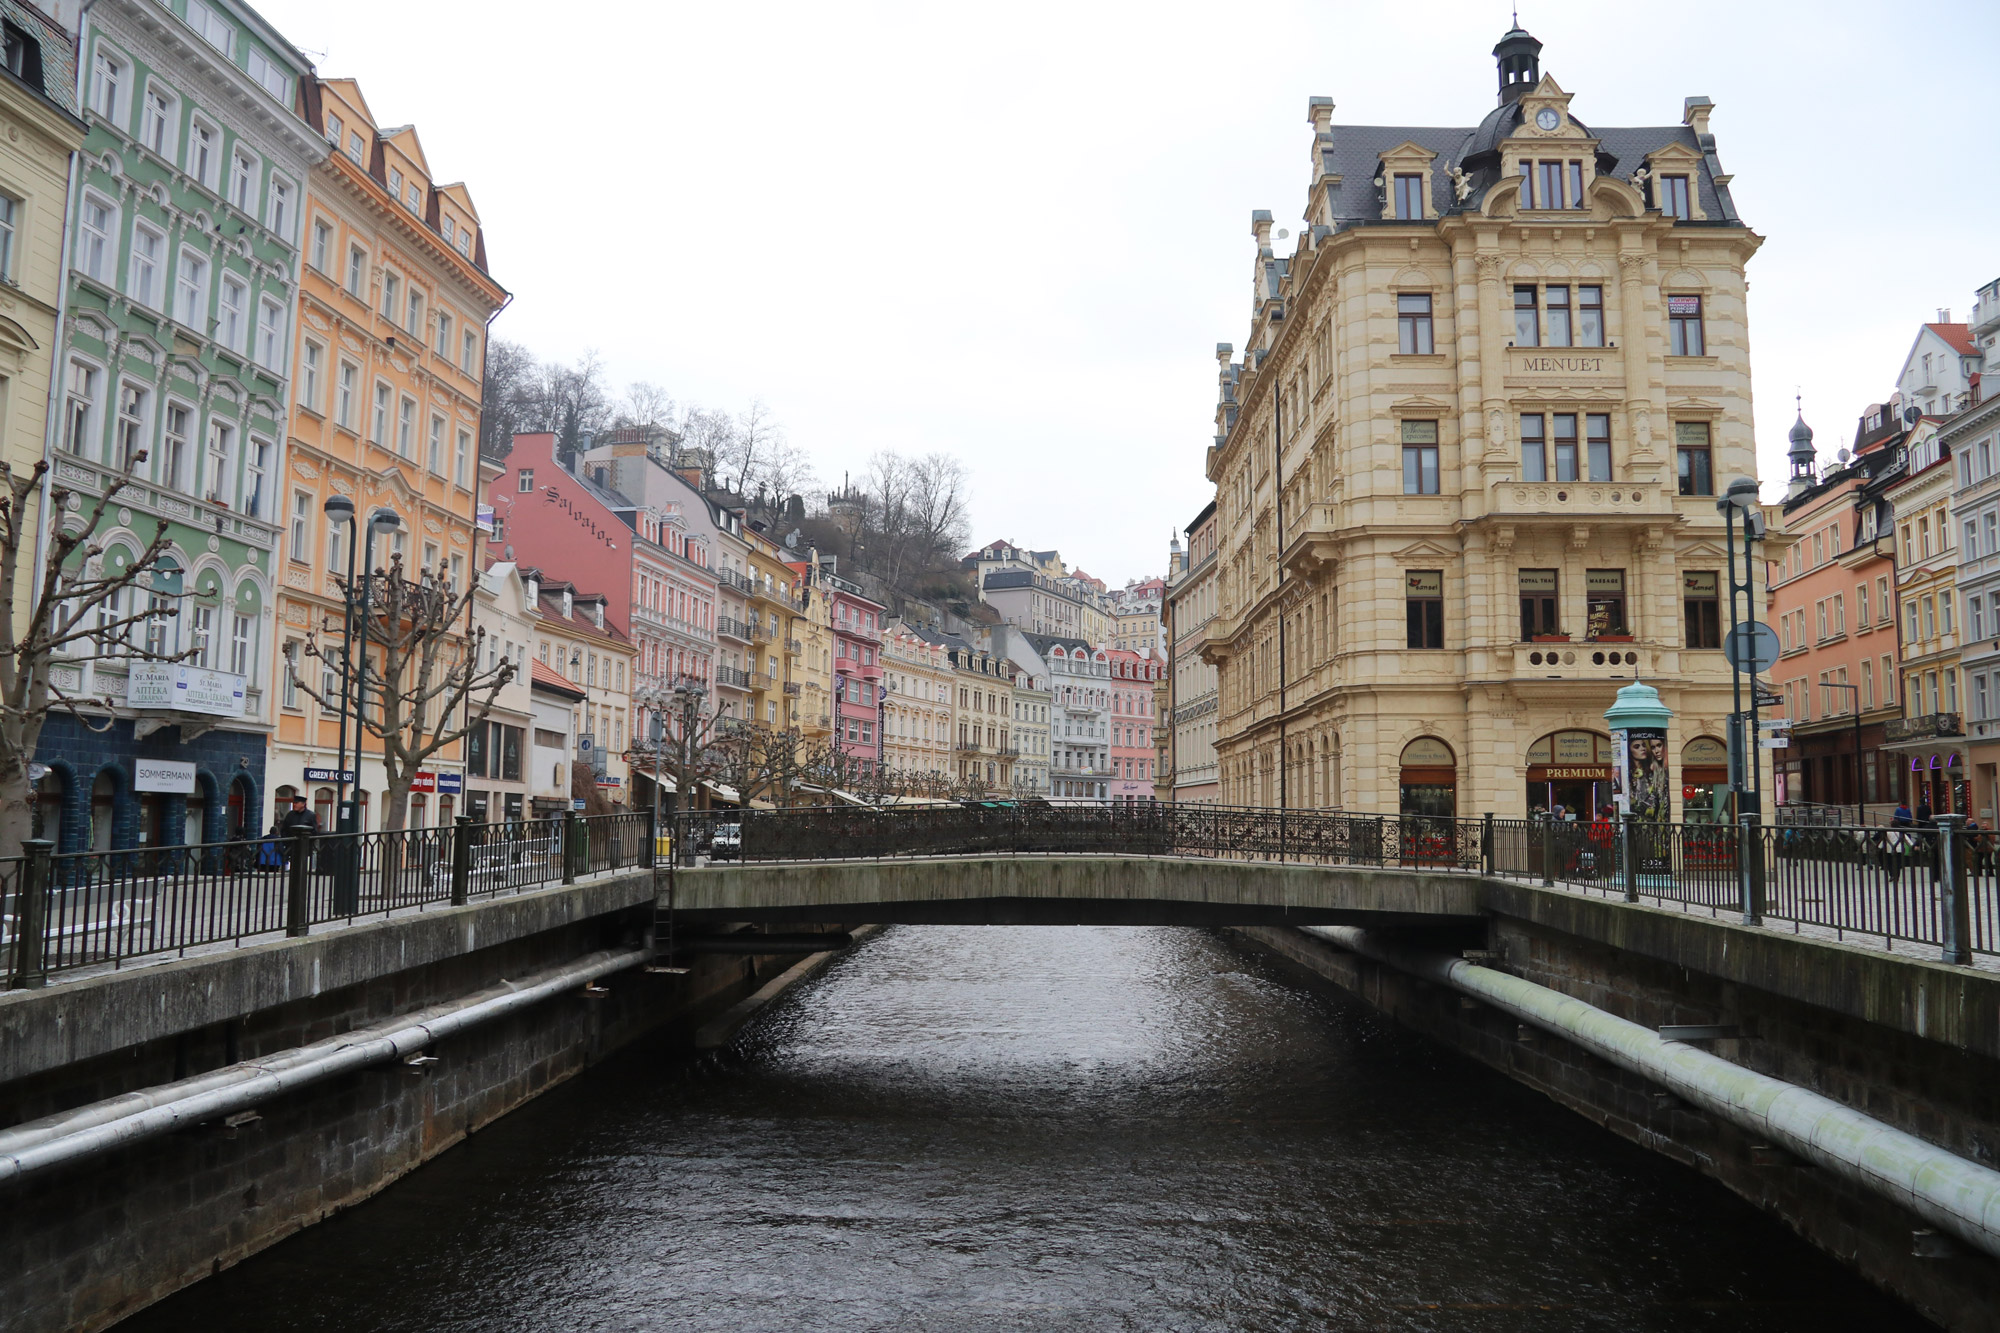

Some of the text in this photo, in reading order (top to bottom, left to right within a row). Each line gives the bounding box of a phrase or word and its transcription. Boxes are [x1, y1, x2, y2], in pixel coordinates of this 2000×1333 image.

[1523, 358, 1604, 372] MENUET
[543, 487, 612, 546] Salvator
[135, 686, 168, 694] АПТЕКА
[207, 680, 222, 689] MARIA
[140, 769, 192, 780] SOMMERMANN
[309, 770, 353, 781] GREEN CAST
[1546, 768, 1606, 778] PREMIUM
